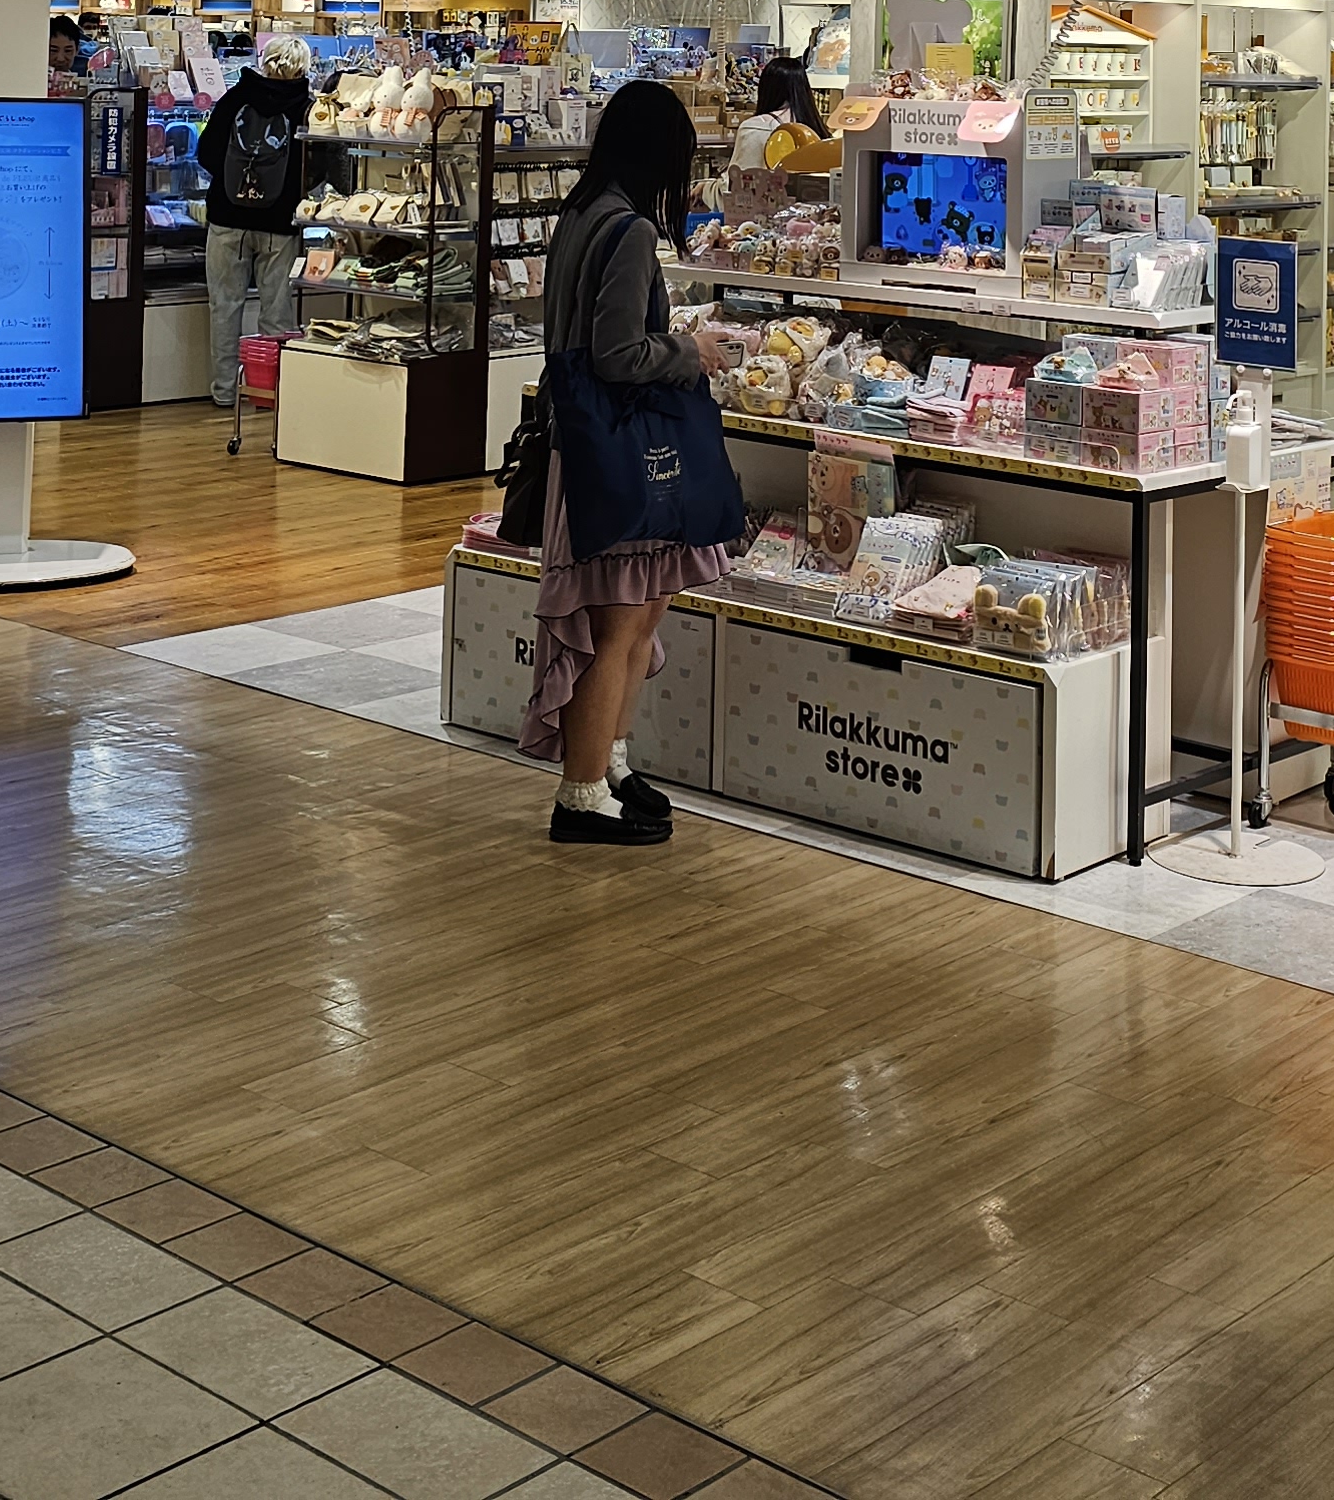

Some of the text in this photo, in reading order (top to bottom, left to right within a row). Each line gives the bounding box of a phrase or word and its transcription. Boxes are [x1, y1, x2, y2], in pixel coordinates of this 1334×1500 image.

[889, 107, 967, 127] Rilakkum
[106, 108, 119, 170] 防犯カメラ設置
[904, 128, 947, 145] store
[1224, 317, 1288, 334] アルコール消毒
[797, 701, 951, 766] Rilakkuma
[825, 745, 899, 790] store
